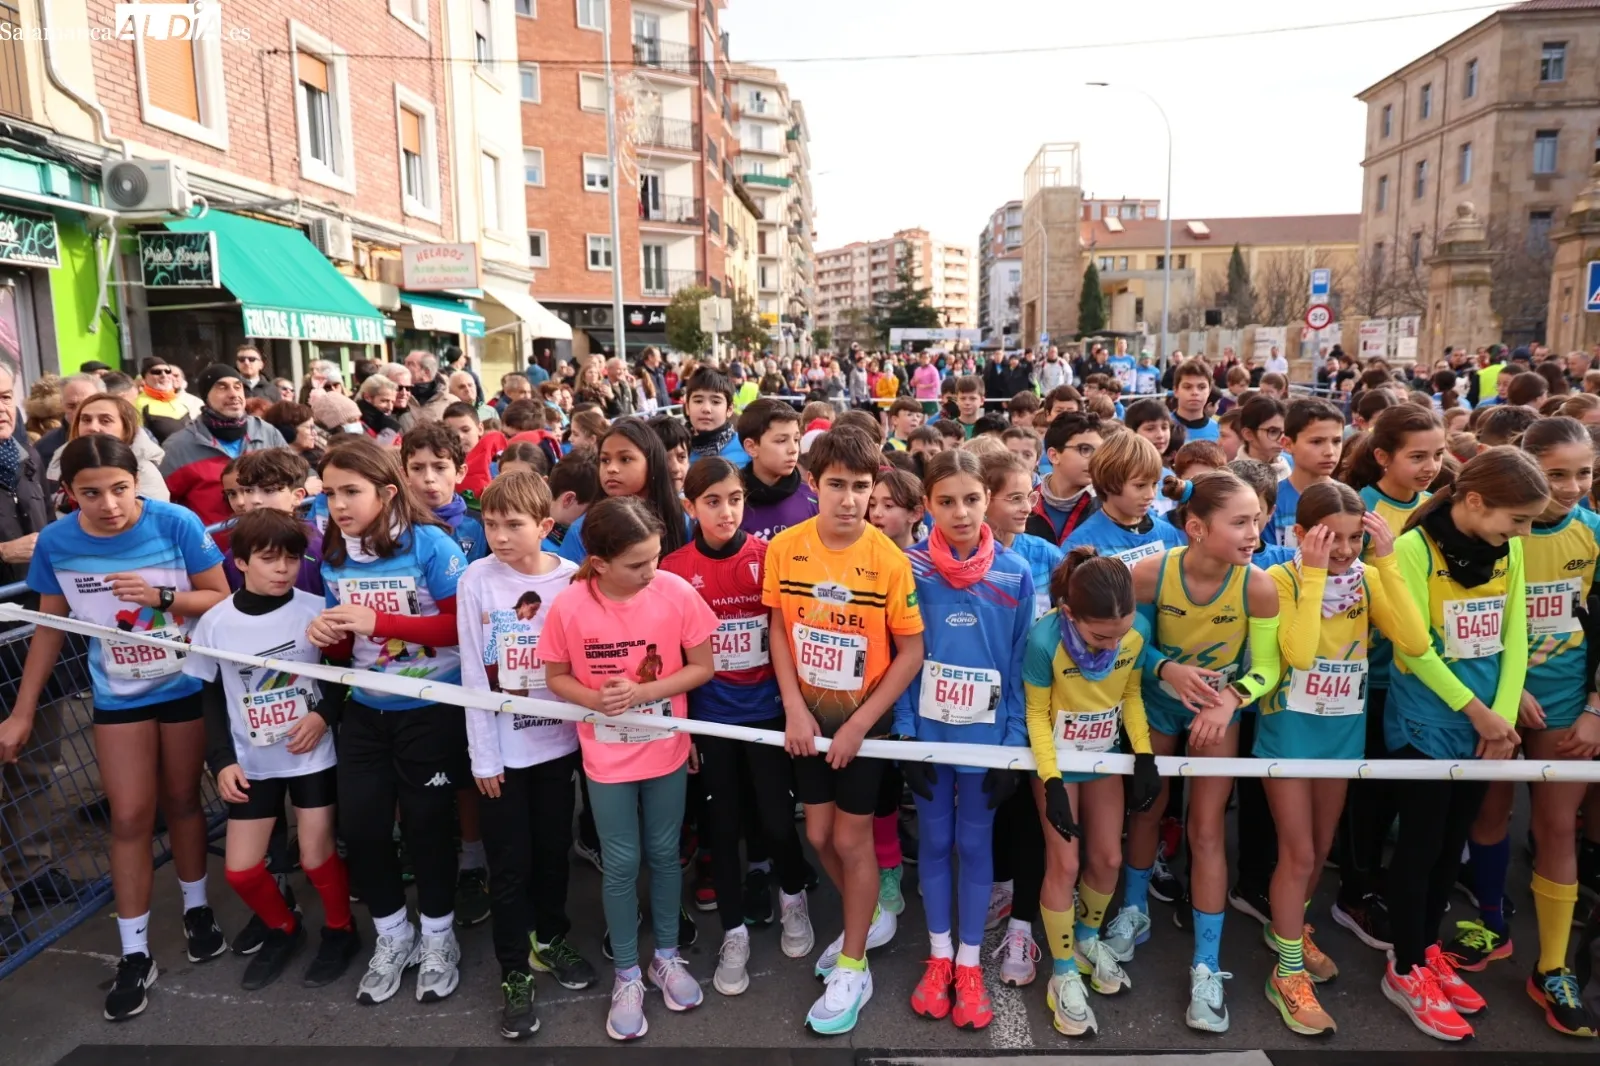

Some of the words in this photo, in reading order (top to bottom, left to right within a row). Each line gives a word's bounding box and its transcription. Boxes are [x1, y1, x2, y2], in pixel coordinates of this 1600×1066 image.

[416, 247, 464, 263] HELADOS
[245, 308, 289, 337] FRUTAS
[290, 311, 299, 337] &
[302, 313, 353, 340] VERDURAS
[1311, 312, 1327, 322] 30
[1121, 545, 1159, 563] SETEL
[359, 580, 407, 590] SETEL
[1525, 583, 1573, 595] SETEL
[717, 620, 763, 631] SETEL
[1456, 612, 1499, 639] 6450
[584, 643, 614, 651] CARRERA
[616, 639, 646, 648] POPULAR
[709, 632, 751, 655] 6413
[810, 631, 860, 648] SETEL
[111, 644, 167, 665] 6388
[507, 648, 546, 670] 640
[585, 648, 629, 659] BONARES
[801, 641, 843, 672] 6531
[942, 668, 993, 682] SETEL
[1318, 663, 1364, 674] SETEL
[935, 679, 974, 707] 6411
[1305, 672, 1351, 697] 6414
[247, 699, 299, 729] 6462
[1063, 720, 1113, 741] 6496
